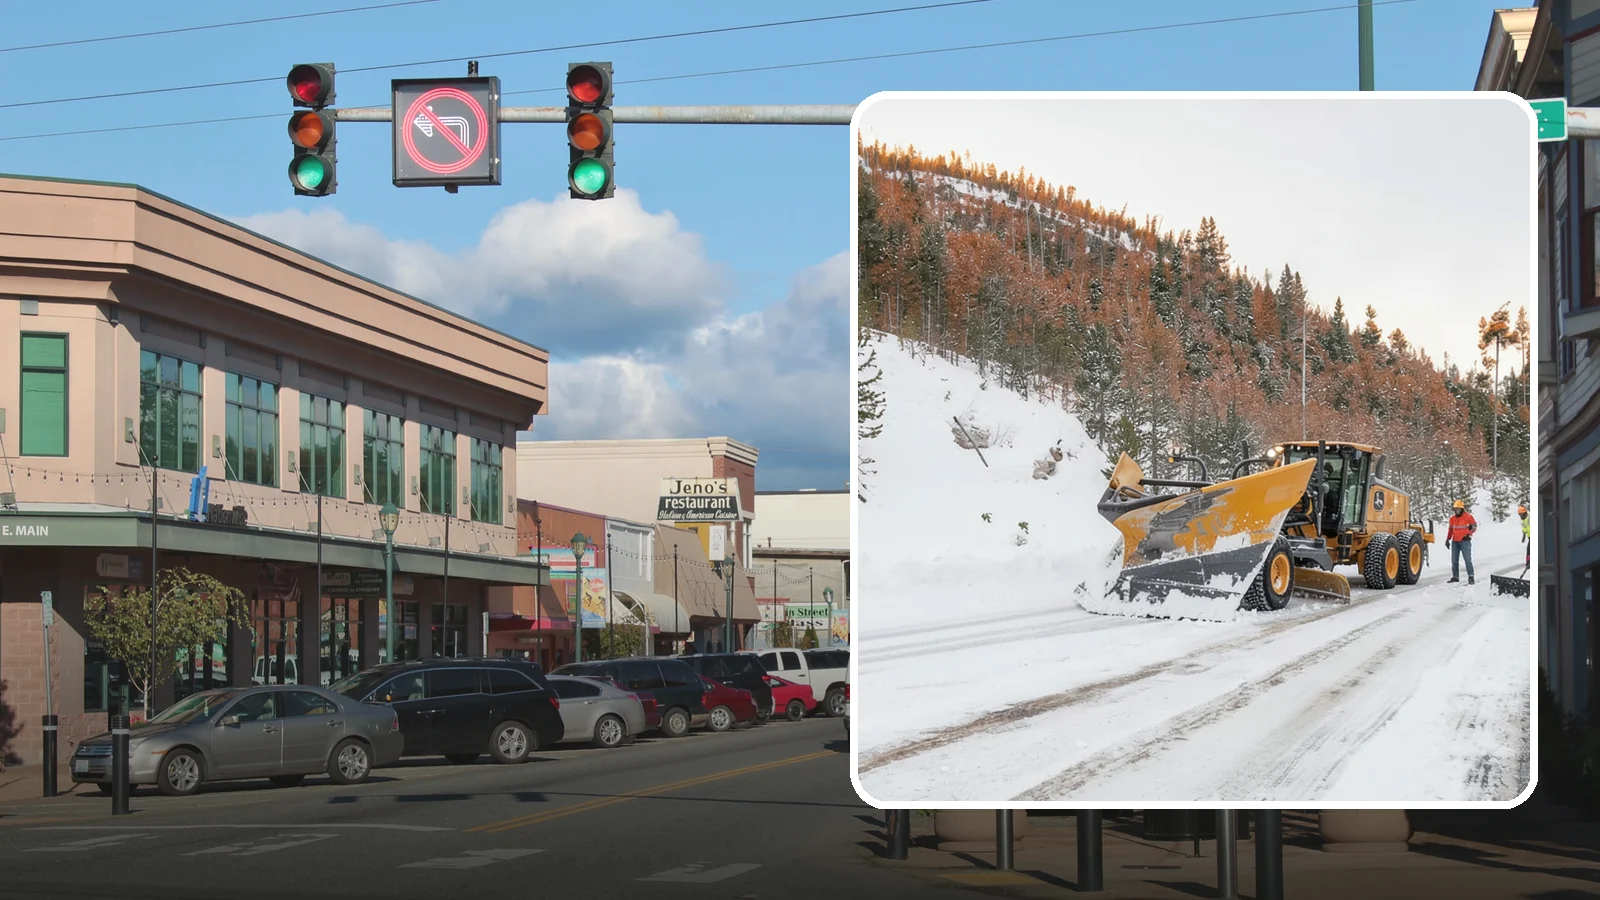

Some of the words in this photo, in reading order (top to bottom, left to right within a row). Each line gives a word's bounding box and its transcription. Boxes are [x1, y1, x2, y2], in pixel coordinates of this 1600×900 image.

[670, 480, 727, 494] Jeno's
[665, 496, 731, 509] restaurant
[658, 510, 682, 519] Italian
[686, 510, 714, 519] American
[715, 510, 737, 519] Cuisine
[2, 525, 13, 536] E.
[15, 525, 49, 536] MAIN
[797, 607, 828, 616] Street
